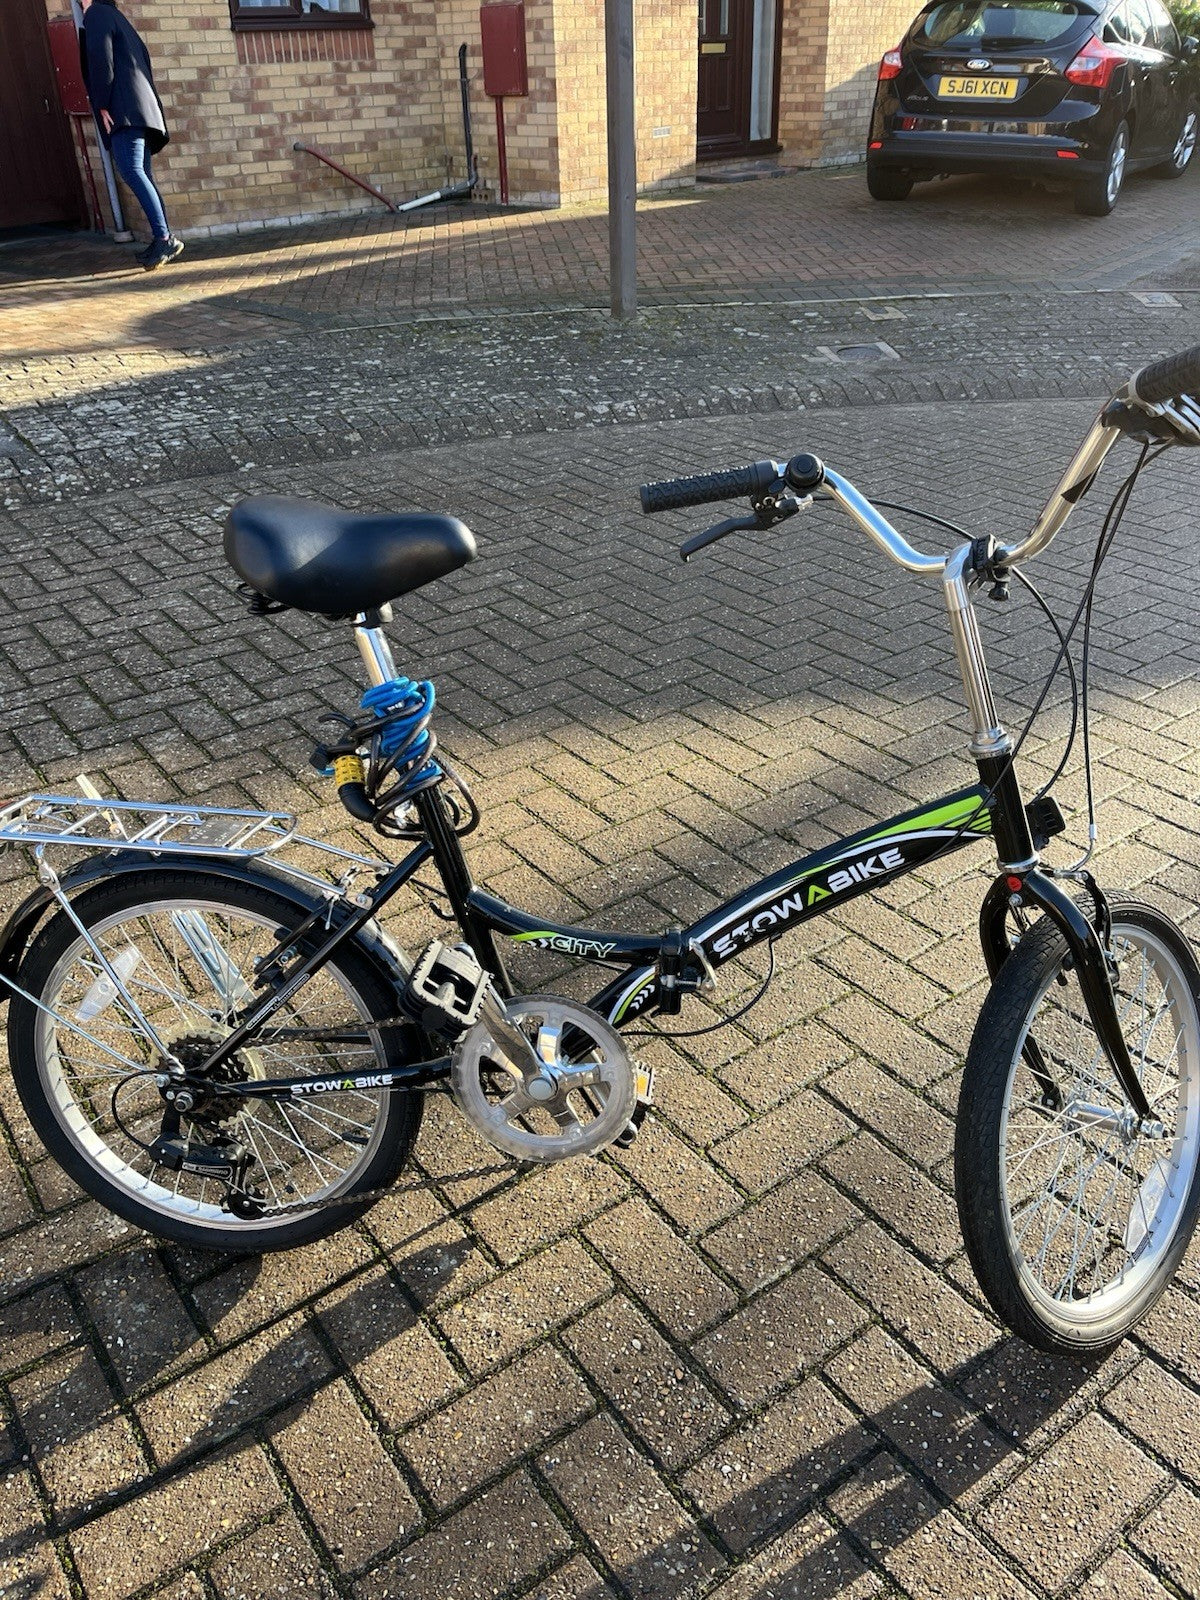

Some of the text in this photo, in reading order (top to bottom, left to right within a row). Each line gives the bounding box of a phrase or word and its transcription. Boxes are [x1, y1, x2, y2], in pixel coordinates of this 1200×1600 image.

[947, 79, 1009, 95] SJ61 XCN
[713, 847, 905, 958] STOWABIKE
[550, 934, 617, 958] CITY
[290, 1073, 394, 1095] STOWABIKE
